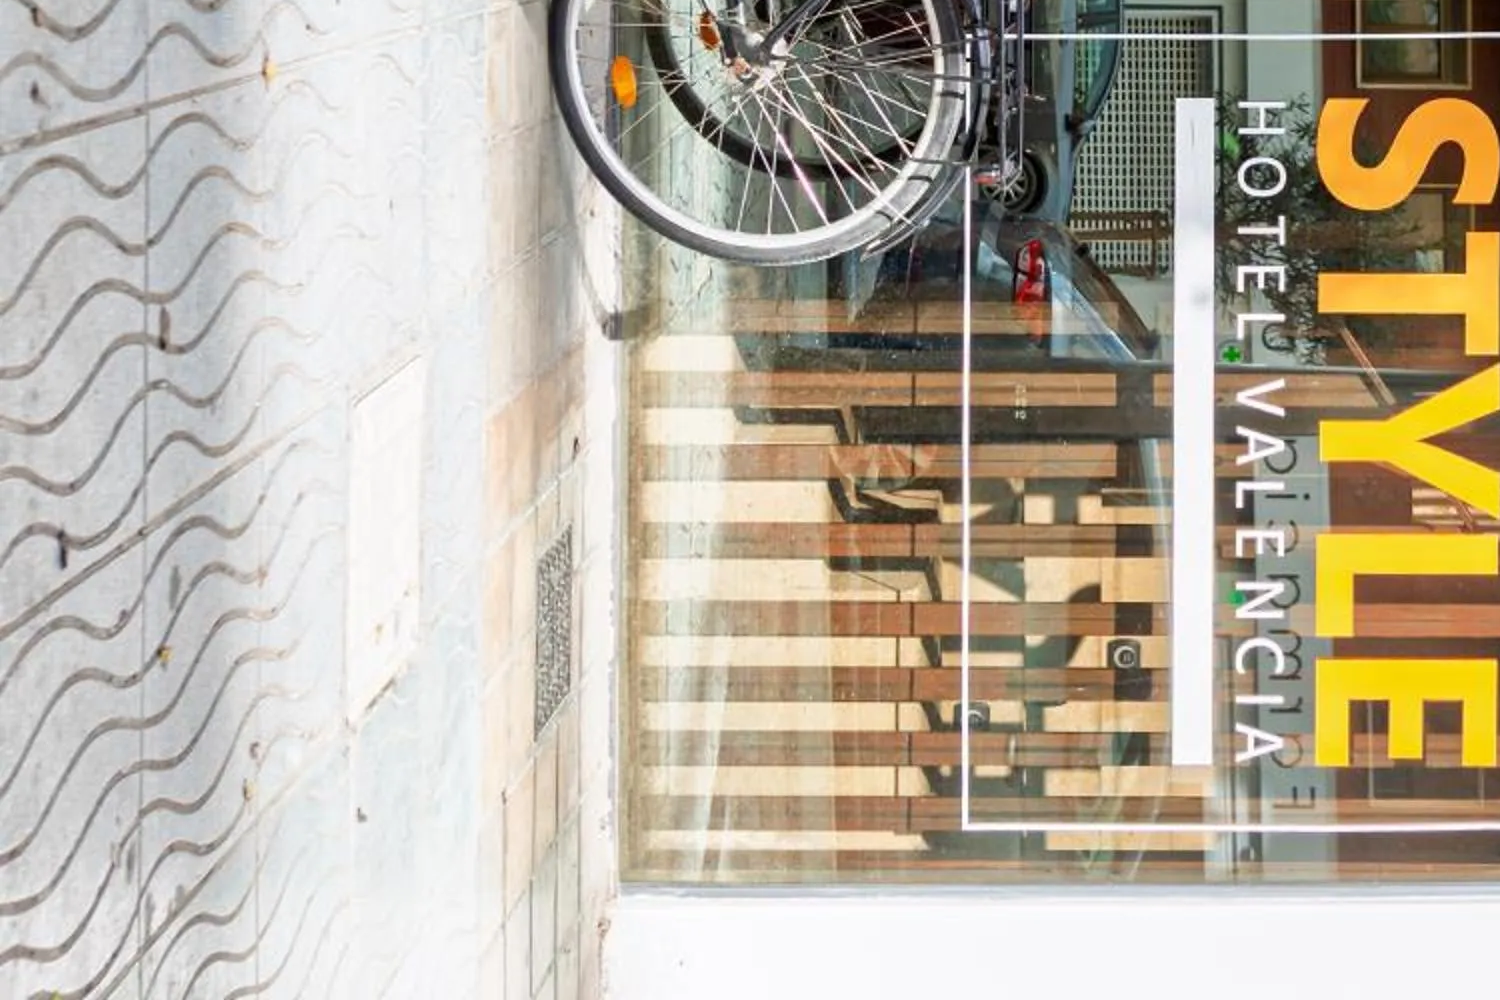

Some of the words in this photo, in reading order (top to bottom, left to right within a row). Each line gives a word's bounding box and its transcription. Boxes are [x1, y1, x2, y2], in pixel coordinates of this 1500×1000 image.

[1234, 100, 1286, 342] HOTEL
[1233, 379, 1286, 764] VALENCIA
[1315, 97, 1500, 767] STYLE
